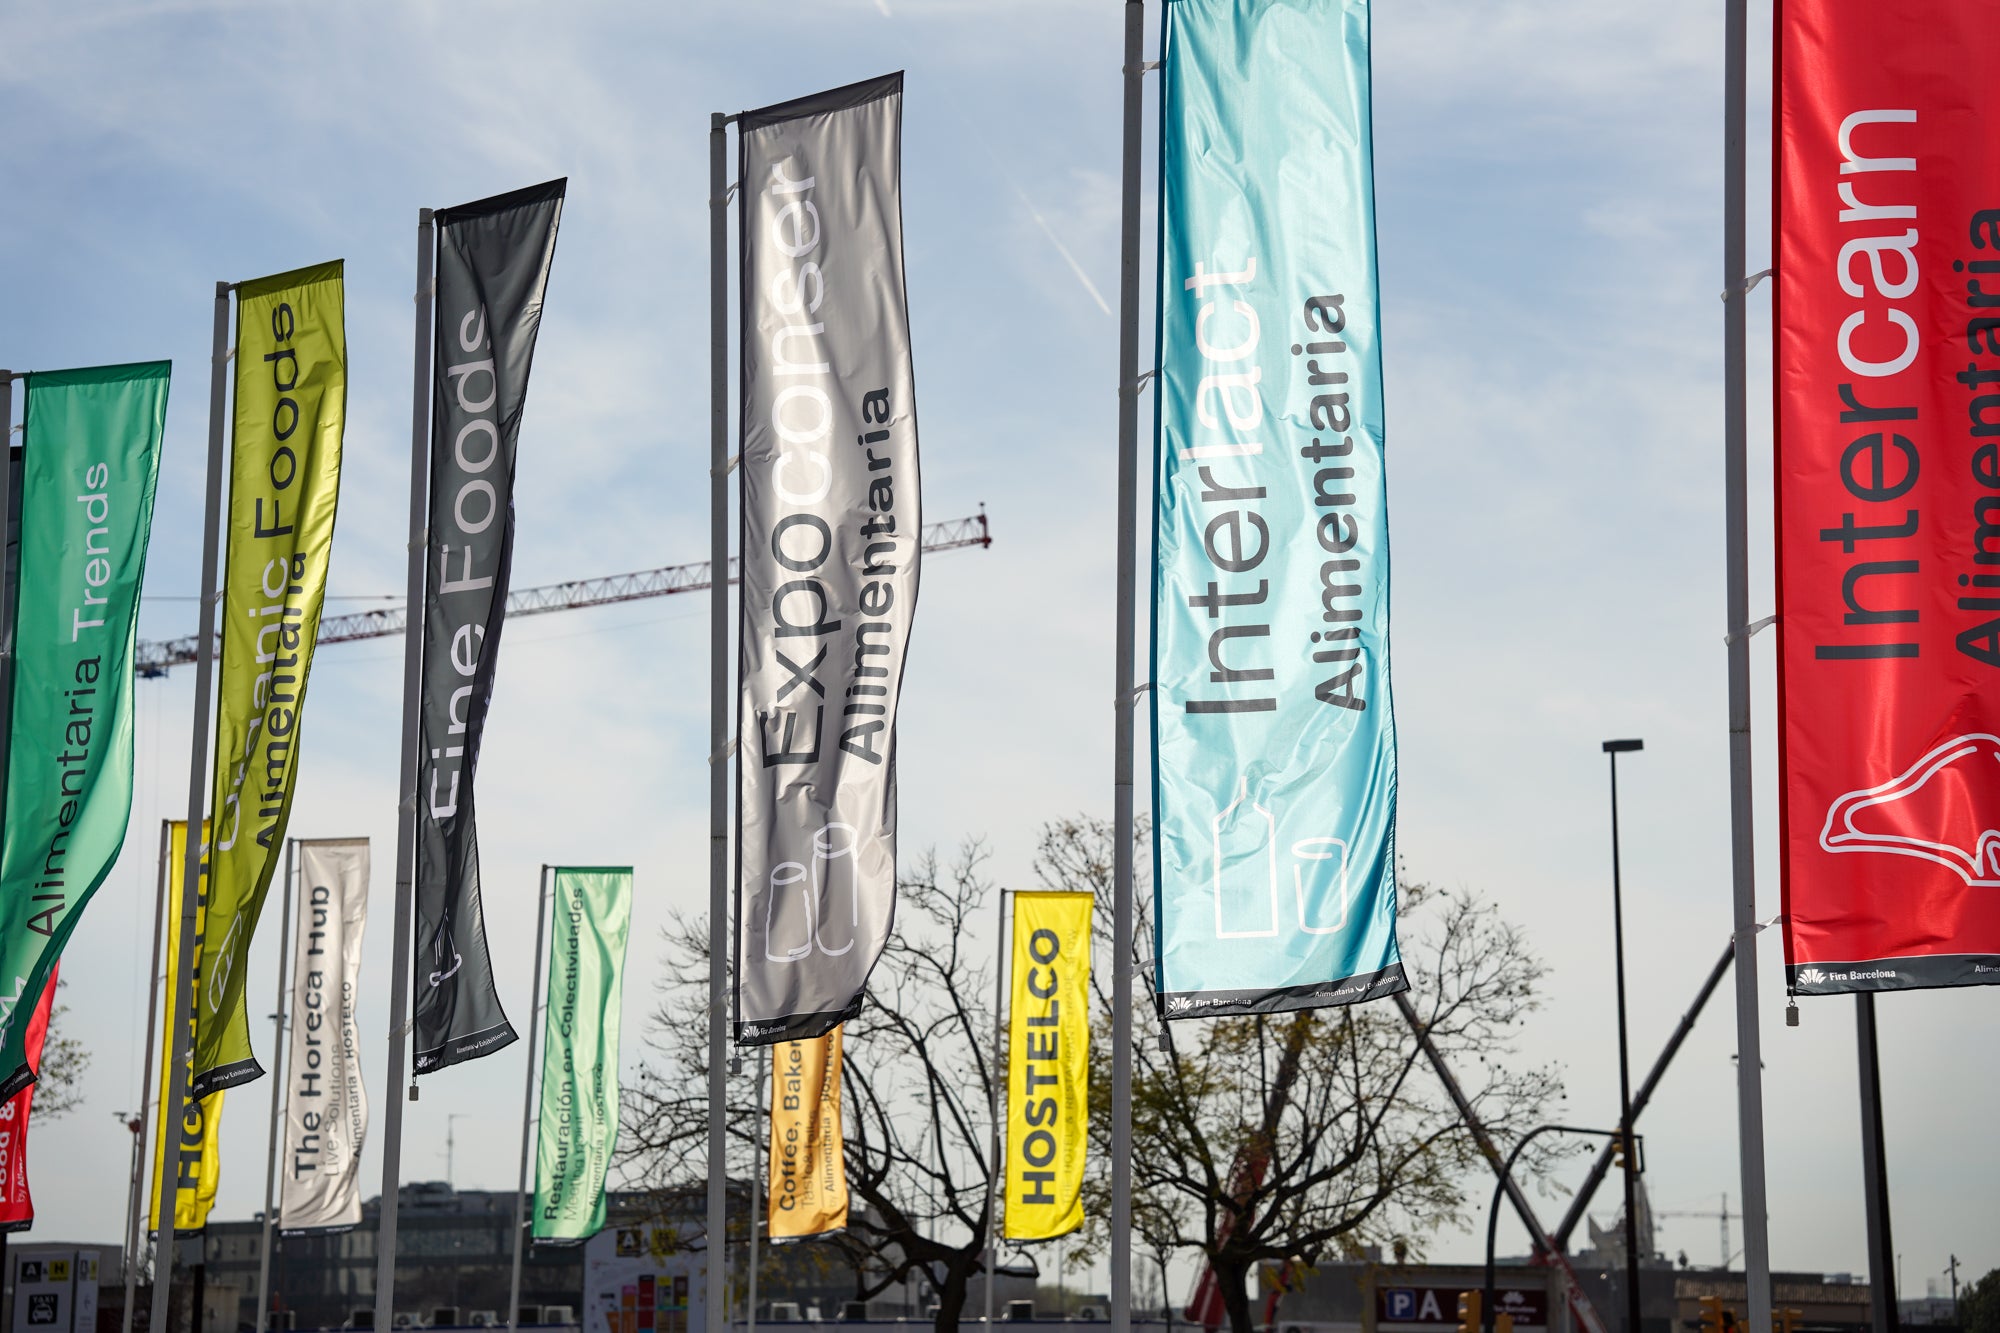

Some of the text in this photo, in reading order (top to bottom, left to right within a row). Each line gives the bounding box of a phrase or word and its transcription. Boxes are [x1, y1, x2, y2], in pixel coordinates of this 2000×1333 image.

[254, 303, 299, 538] Foods
[440, 303, 498, 594] Foods
[760, 154, 841, 768] Expoconser
[1179, 257, 1277, 714] Interlact
[1815, 109, 1920, 660] Intercarn
[839, 387, 897, 766] Alimentaria
[1290, 293, 1366, 712] Alimentaria
[27, 462, 111, 936] Alimentaria Trends
[430, 623, 486, 819] Fine
[295, 885, 330, 1180] The Horeca Hub
[342, 982, 355, 1059] HOSTELCO
[561, 887, 584, 1038] Colectividades
[563, 1048, 573, 1073] en
[1022, 928, 1060, 1204] HOSTELCO
[1829, 969, 1896, 981] Fira Barcelona
[324, 1043, 342, 1177] Live Solutions
[543, 1081, 573, 1220] Restauración
[779, 1121, 801, 1211] Coffee,
[26, 1263, 37, 1276] A
[54, 1263, 65, 1274] H
[1393, 1289, 1442, 1321] P A
